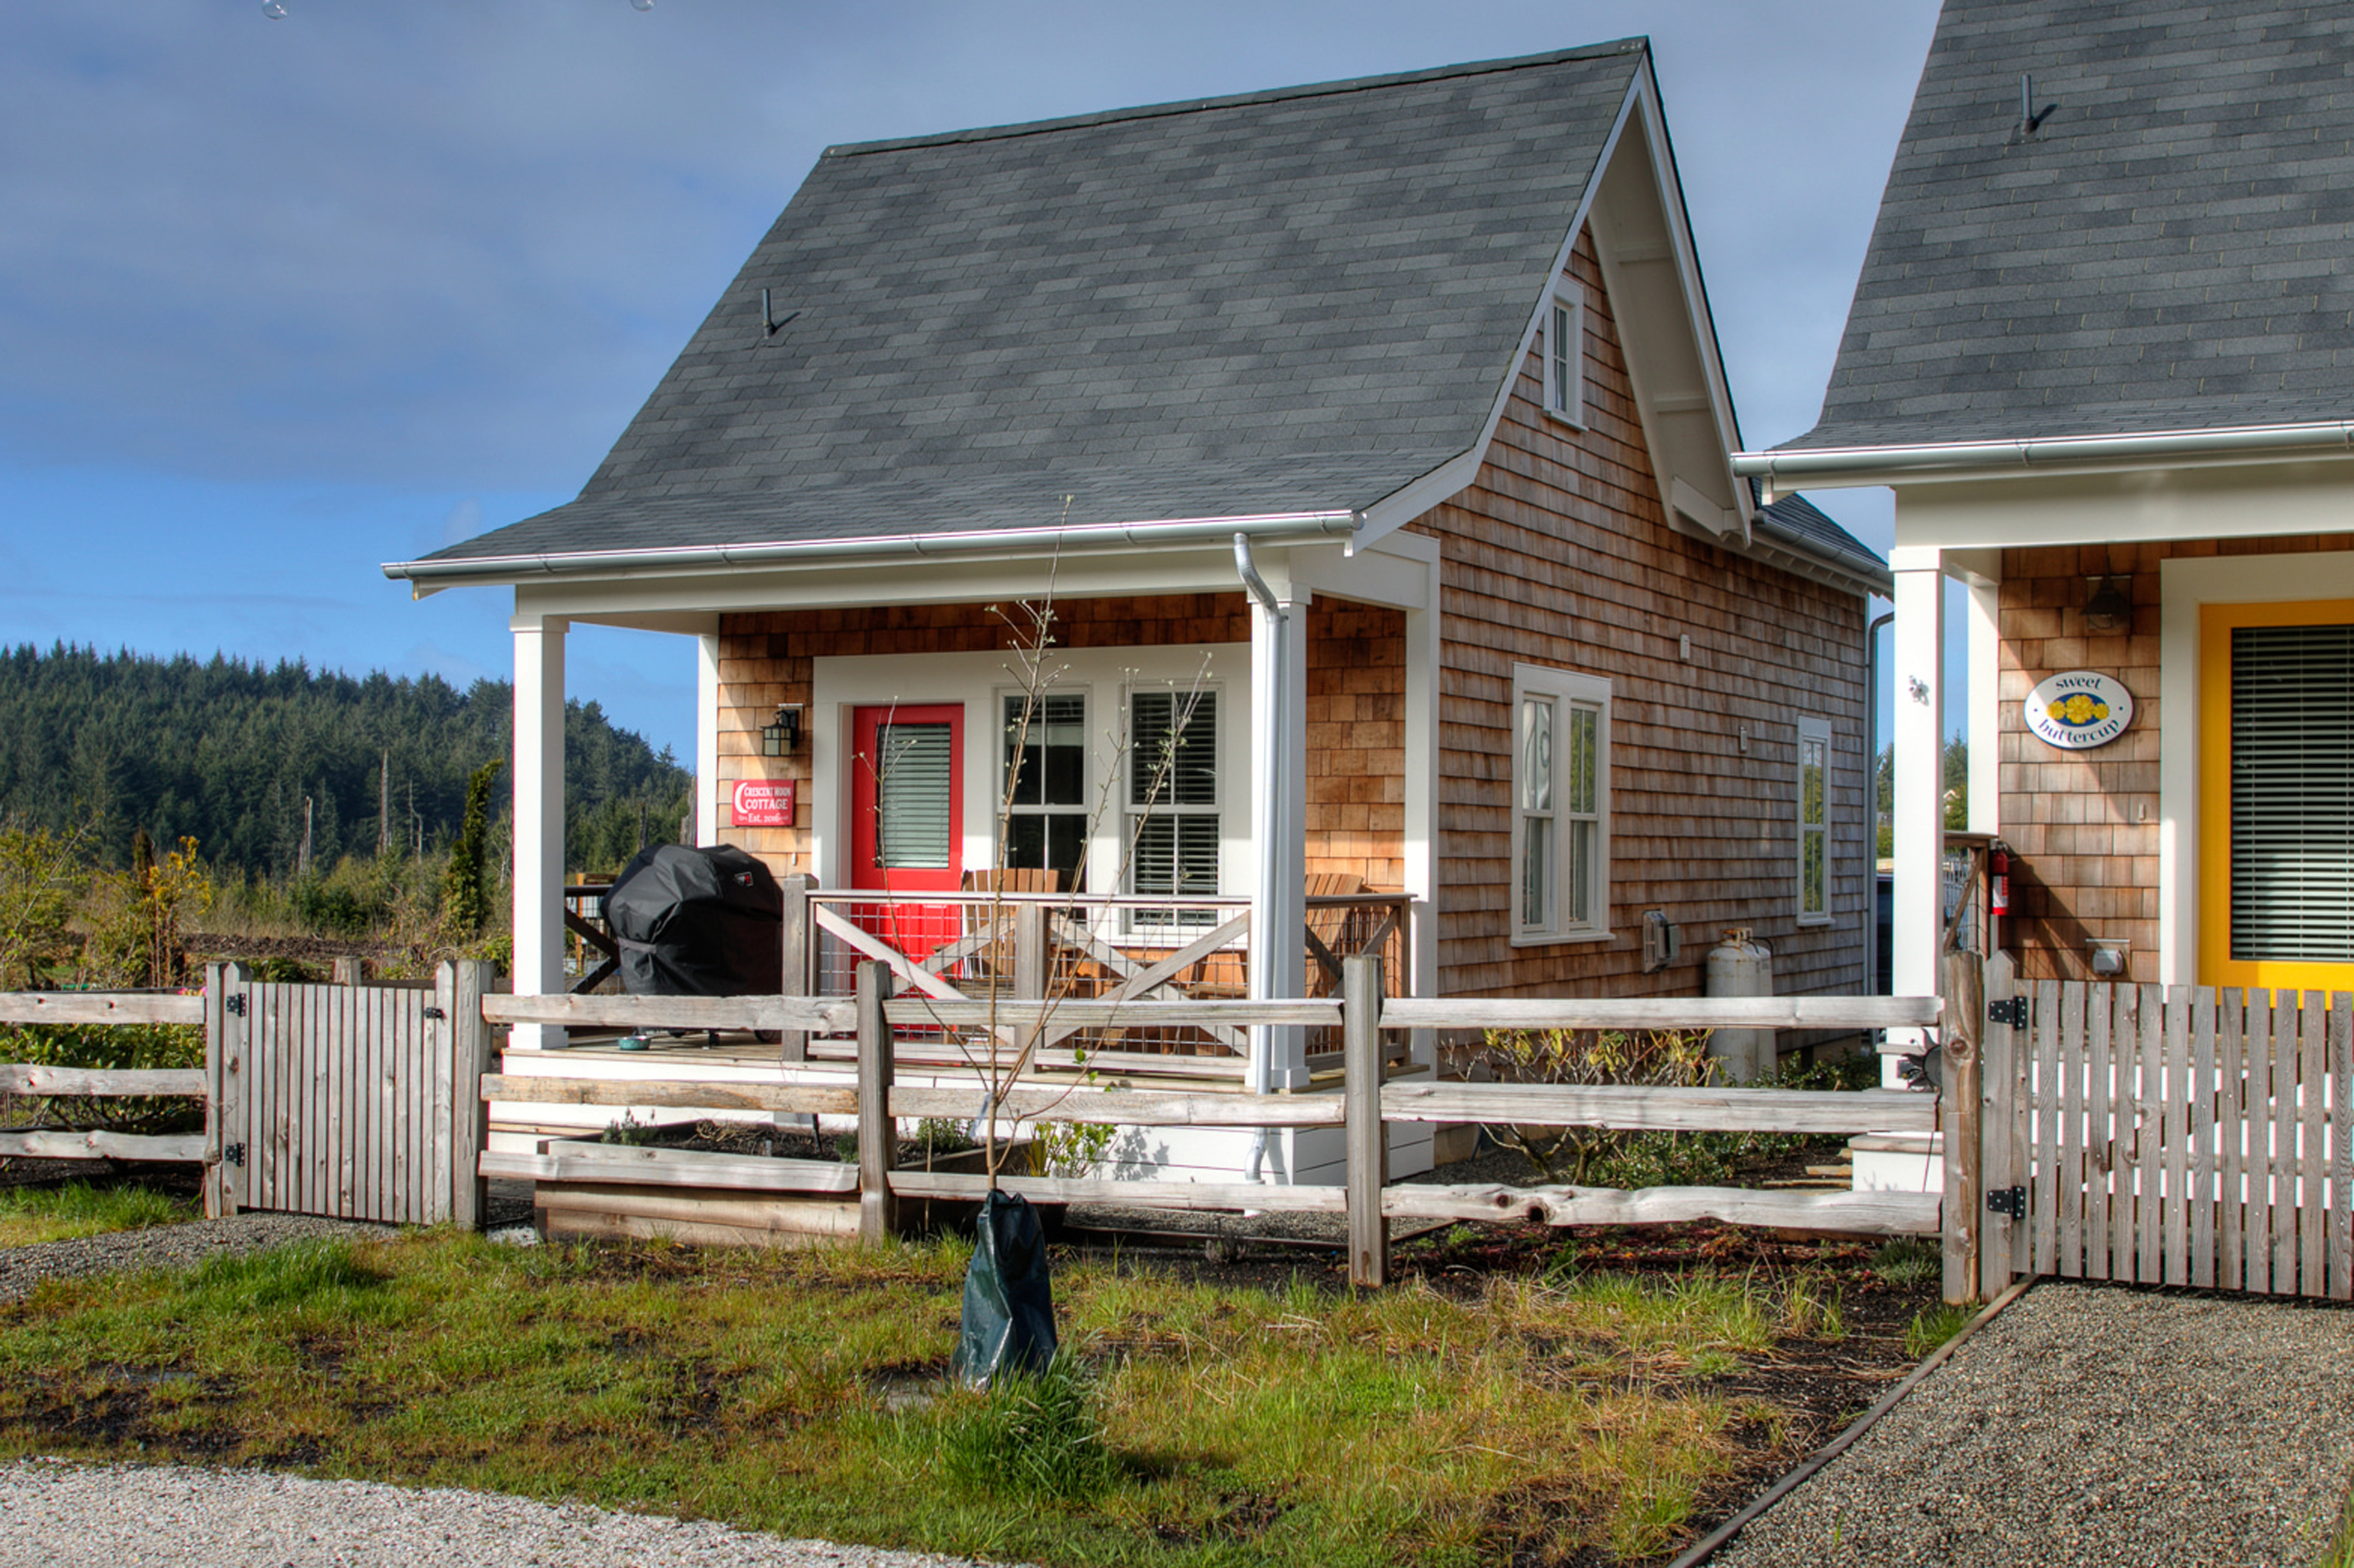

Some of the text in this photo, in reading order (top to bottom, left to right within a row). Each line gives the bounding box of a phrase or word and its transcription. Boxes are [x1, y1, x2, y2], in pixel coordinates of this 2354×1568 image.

[2056, 677, 2102, 690] sweet
[2039, 719, 2119, 743] buttercup
[744, 786, 791, 797] CRESCENT MOON
[745, 798, 788, 810] COTTAGE
[748, 813, 762, 822] Est.
